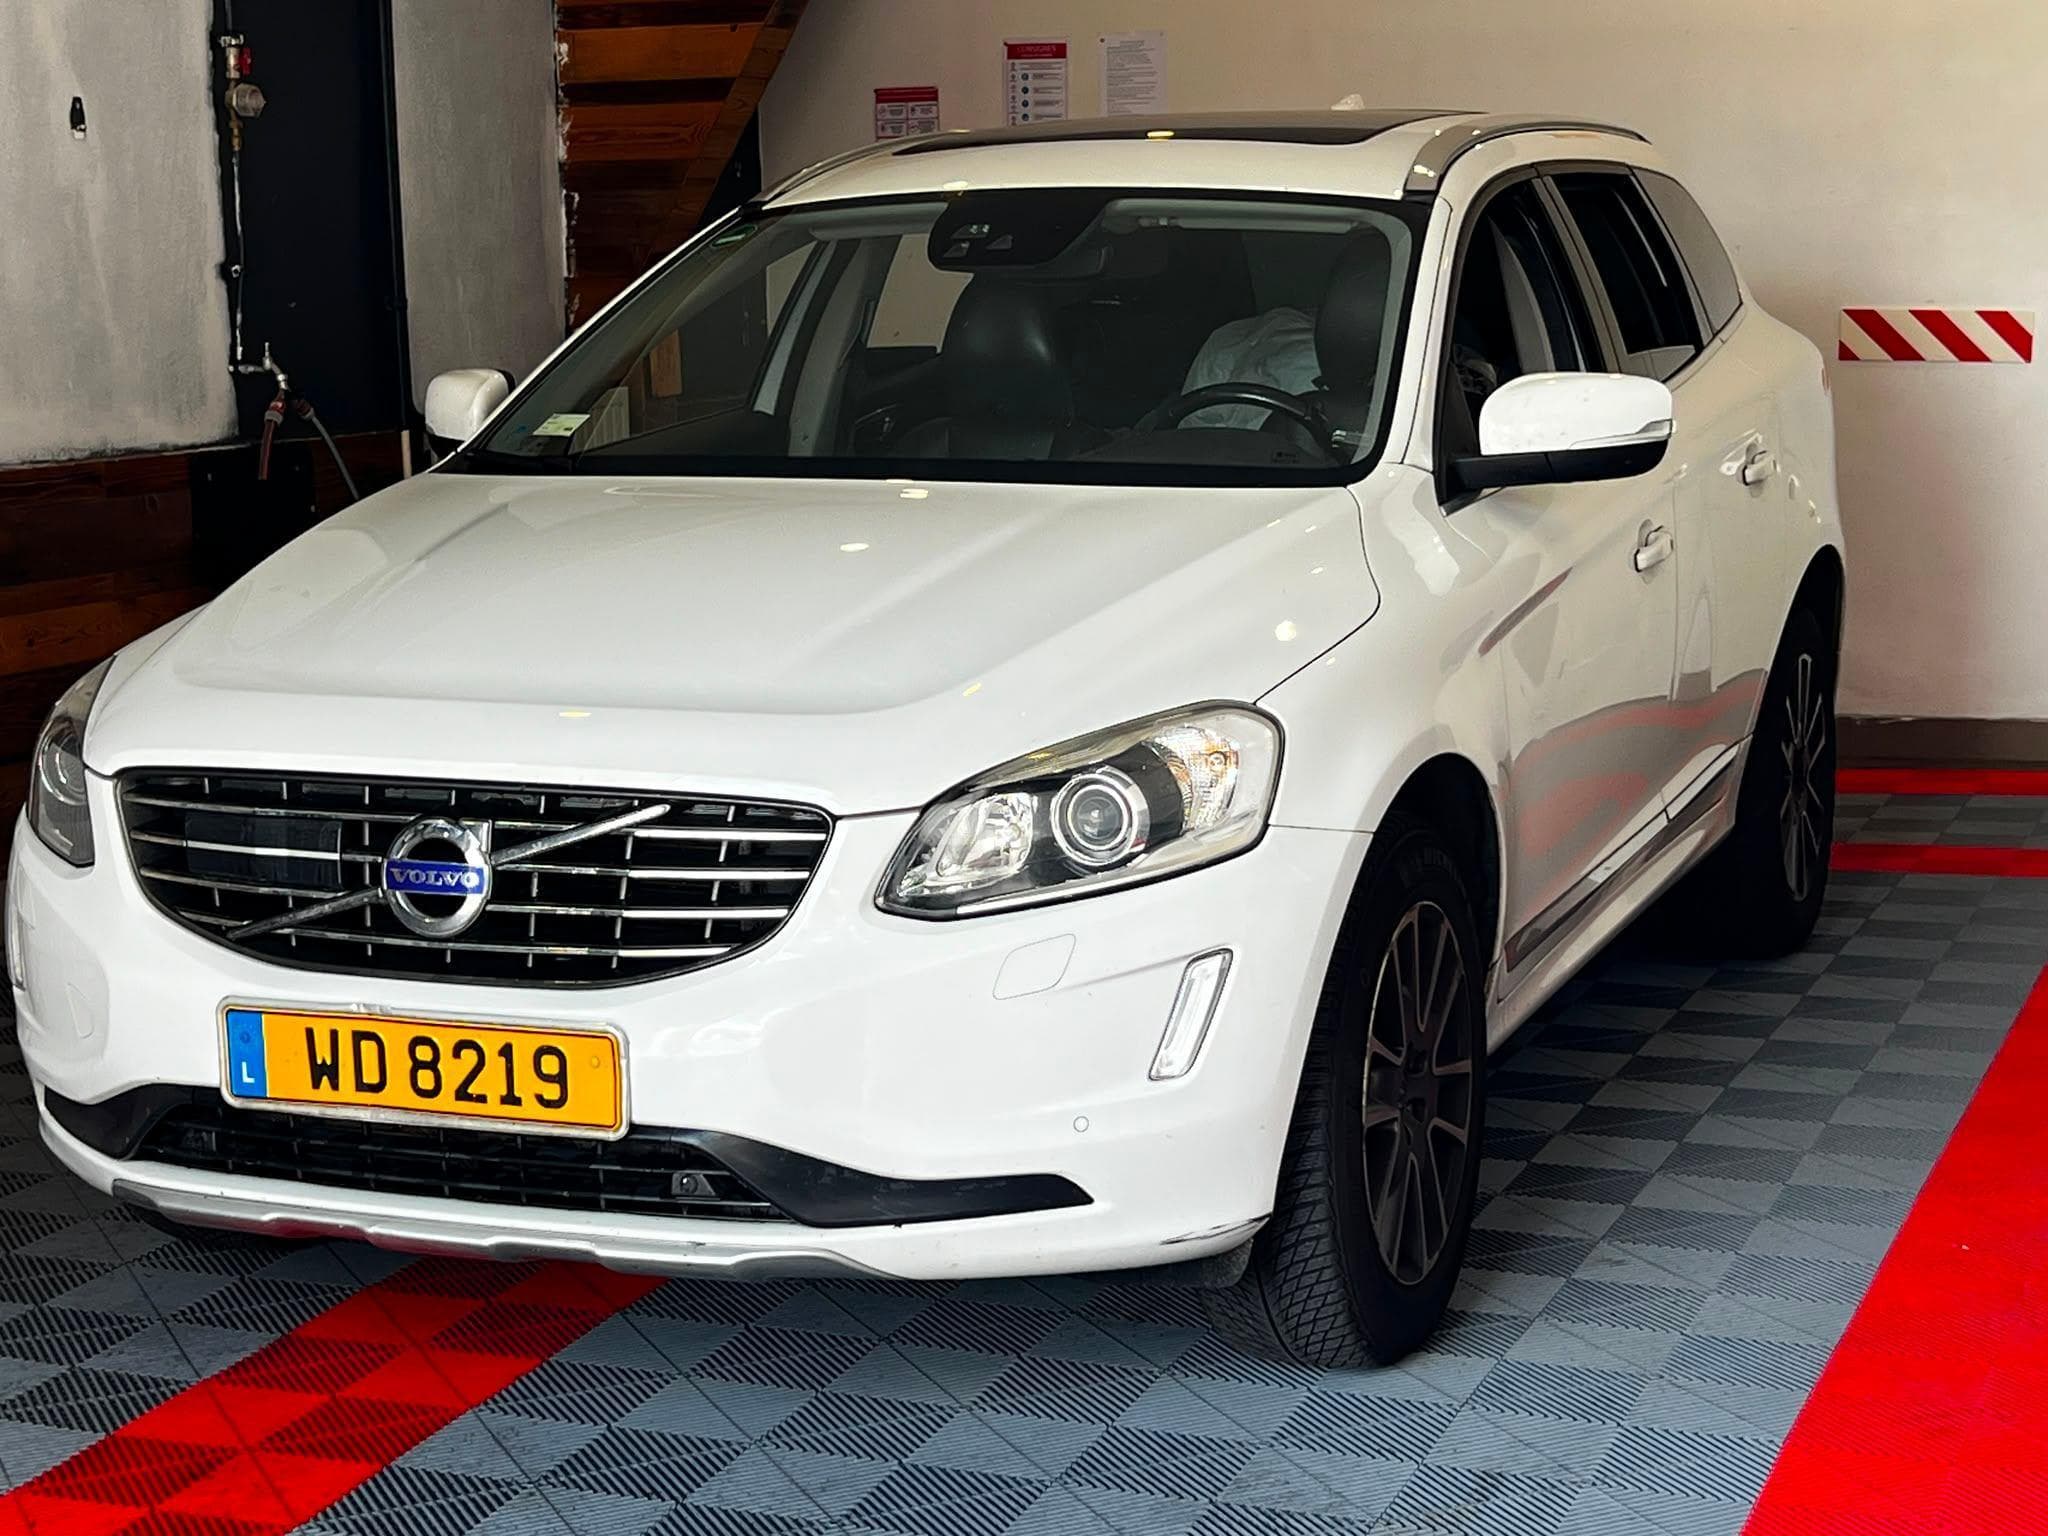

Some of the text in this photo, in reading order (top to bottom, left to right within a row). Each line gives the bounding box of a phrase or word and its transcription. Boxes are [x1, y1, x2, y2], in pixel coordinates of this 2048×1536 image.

[389, 867, 480, 889] VOLVO
[240, 1060, 255, 1084] L
[305, 1026, 569, 1109] WD 8219
